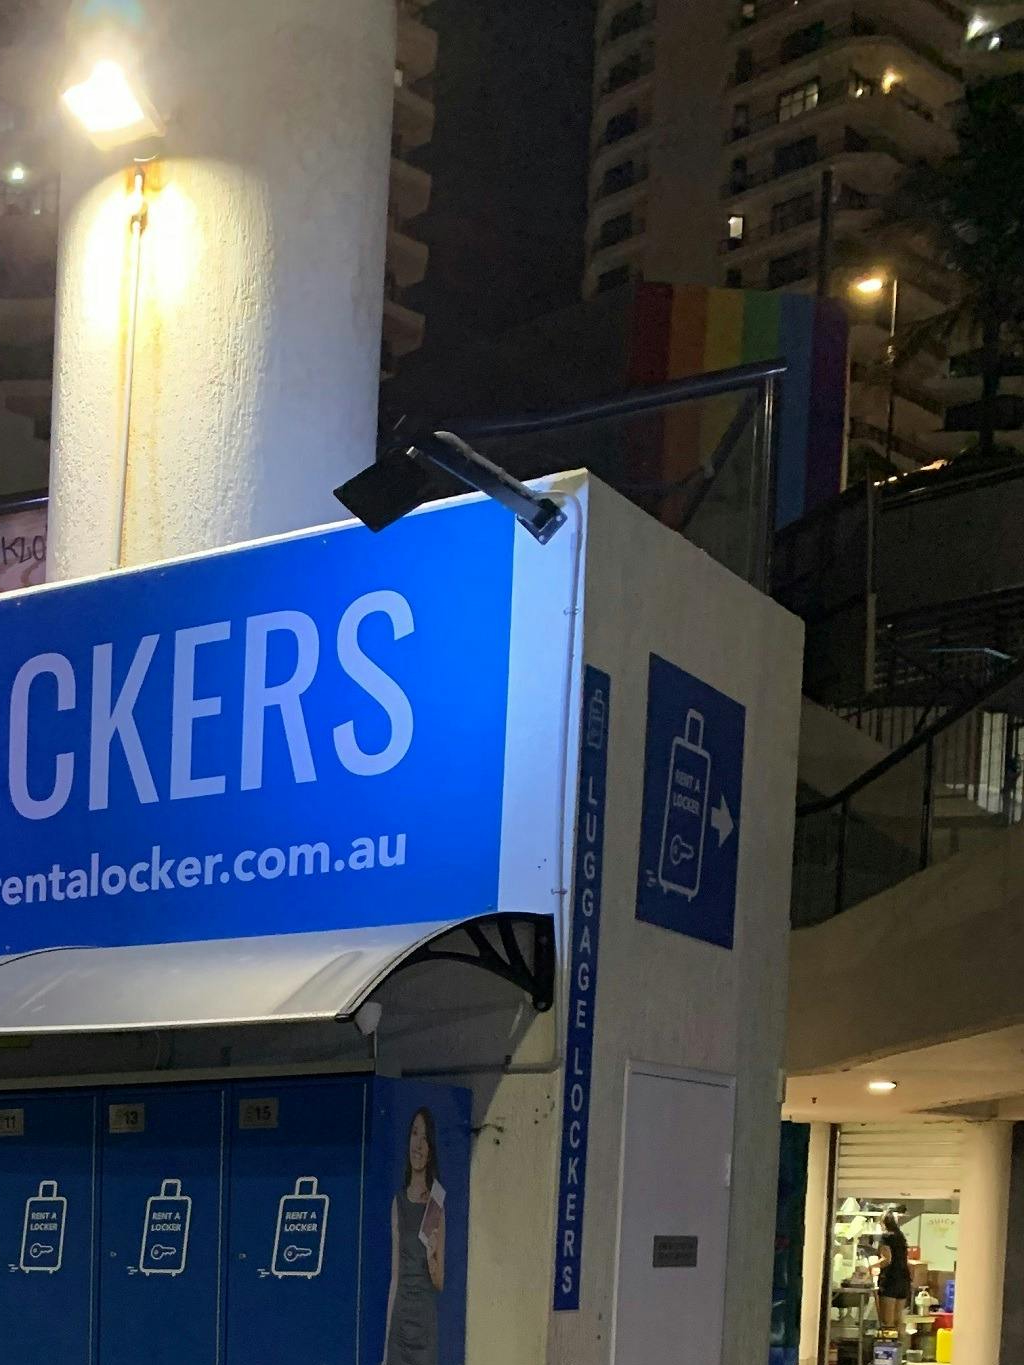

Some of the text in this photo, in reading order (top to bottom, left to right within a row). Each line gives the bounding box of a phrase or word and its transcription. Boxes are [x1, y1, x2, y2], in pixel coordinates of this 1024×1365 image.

[576, 776, 597, 1029] LUGGAGE
[124, 1111, 139, 1125] 13
[256, 1105, 272, 1121] 15
[4, 1115, 16, 1129] 11
[561, 1048, 584, 1294] LOCKERS
[285, 1211, 307, 1220] RENT
[284, 1223, 318, 1232] LOCKER
